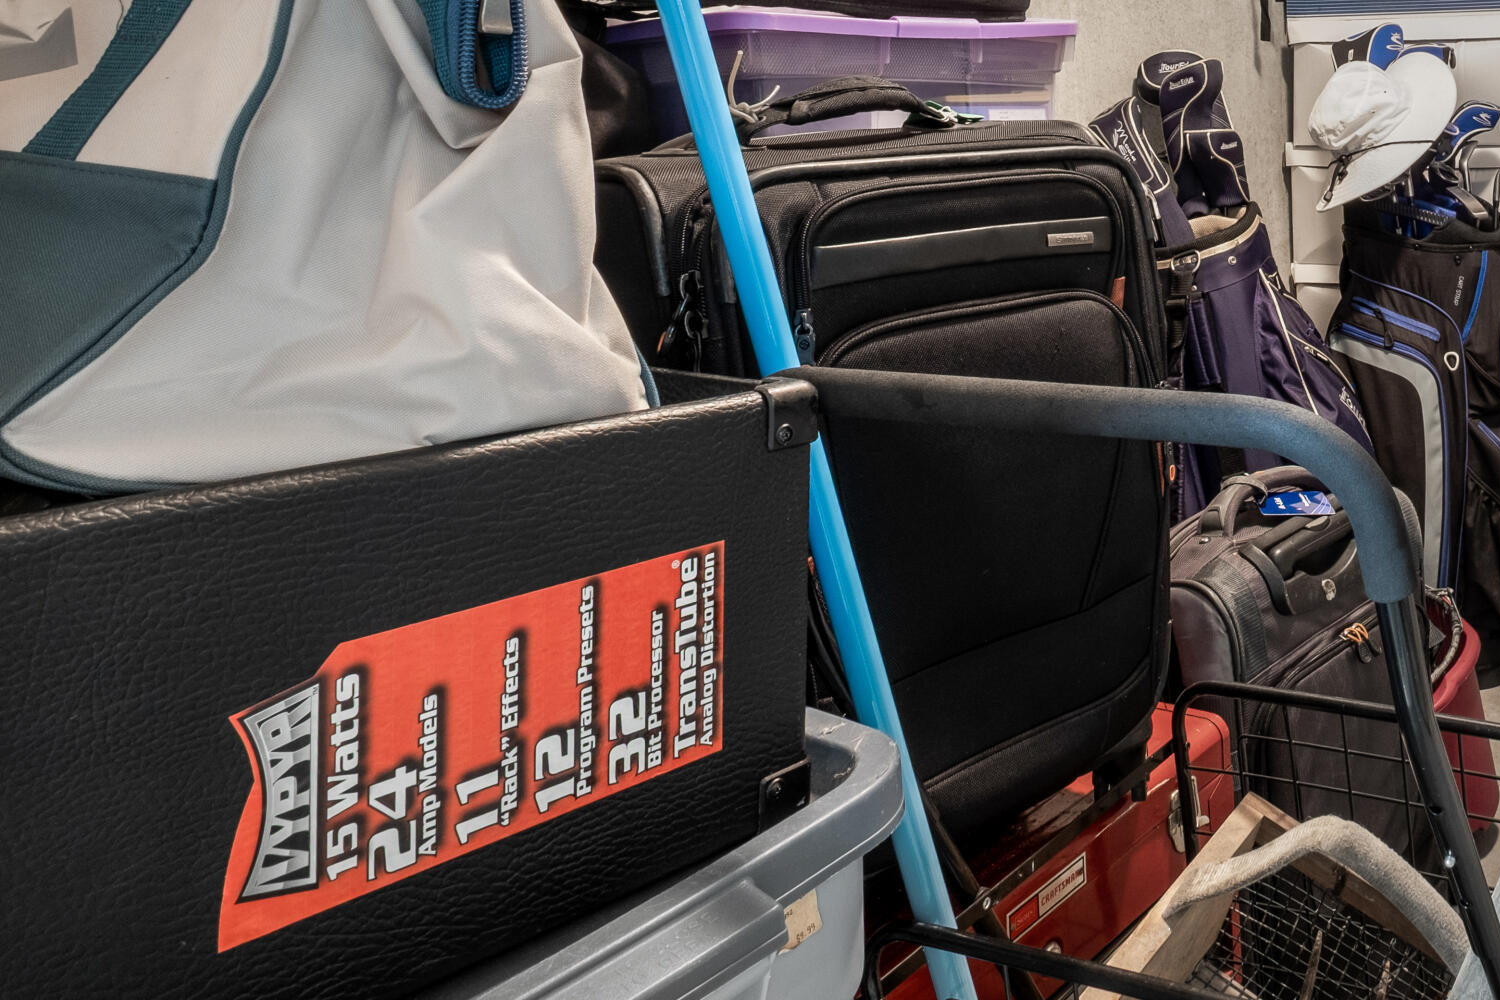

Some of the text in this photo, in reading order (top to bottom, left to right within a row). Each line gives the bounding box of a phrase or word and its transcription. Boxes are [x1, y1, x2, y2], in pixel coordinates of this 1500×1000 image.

[501, 636, 519, 732] Effects
[576, 585, 595, 798] Program Presets
[648, 610, 664, 769] Bit Processor
[673, 556, 698, 758] TransTube
[700, 552, 717, 745] Analog Distortion
[248, 685, 318, 893] VYPYR
[326, 673, 360, 881] 15 Watts
[419, 694, 441, 856] Amp Models
[456, 768, 499, 845] 11
[534, 728, 575, 814] 12
[608, 691, 646, 785] 32
[367, 765, 418, 881] 24
[1040, 867, 1084, 907] CRAFTSMAN
